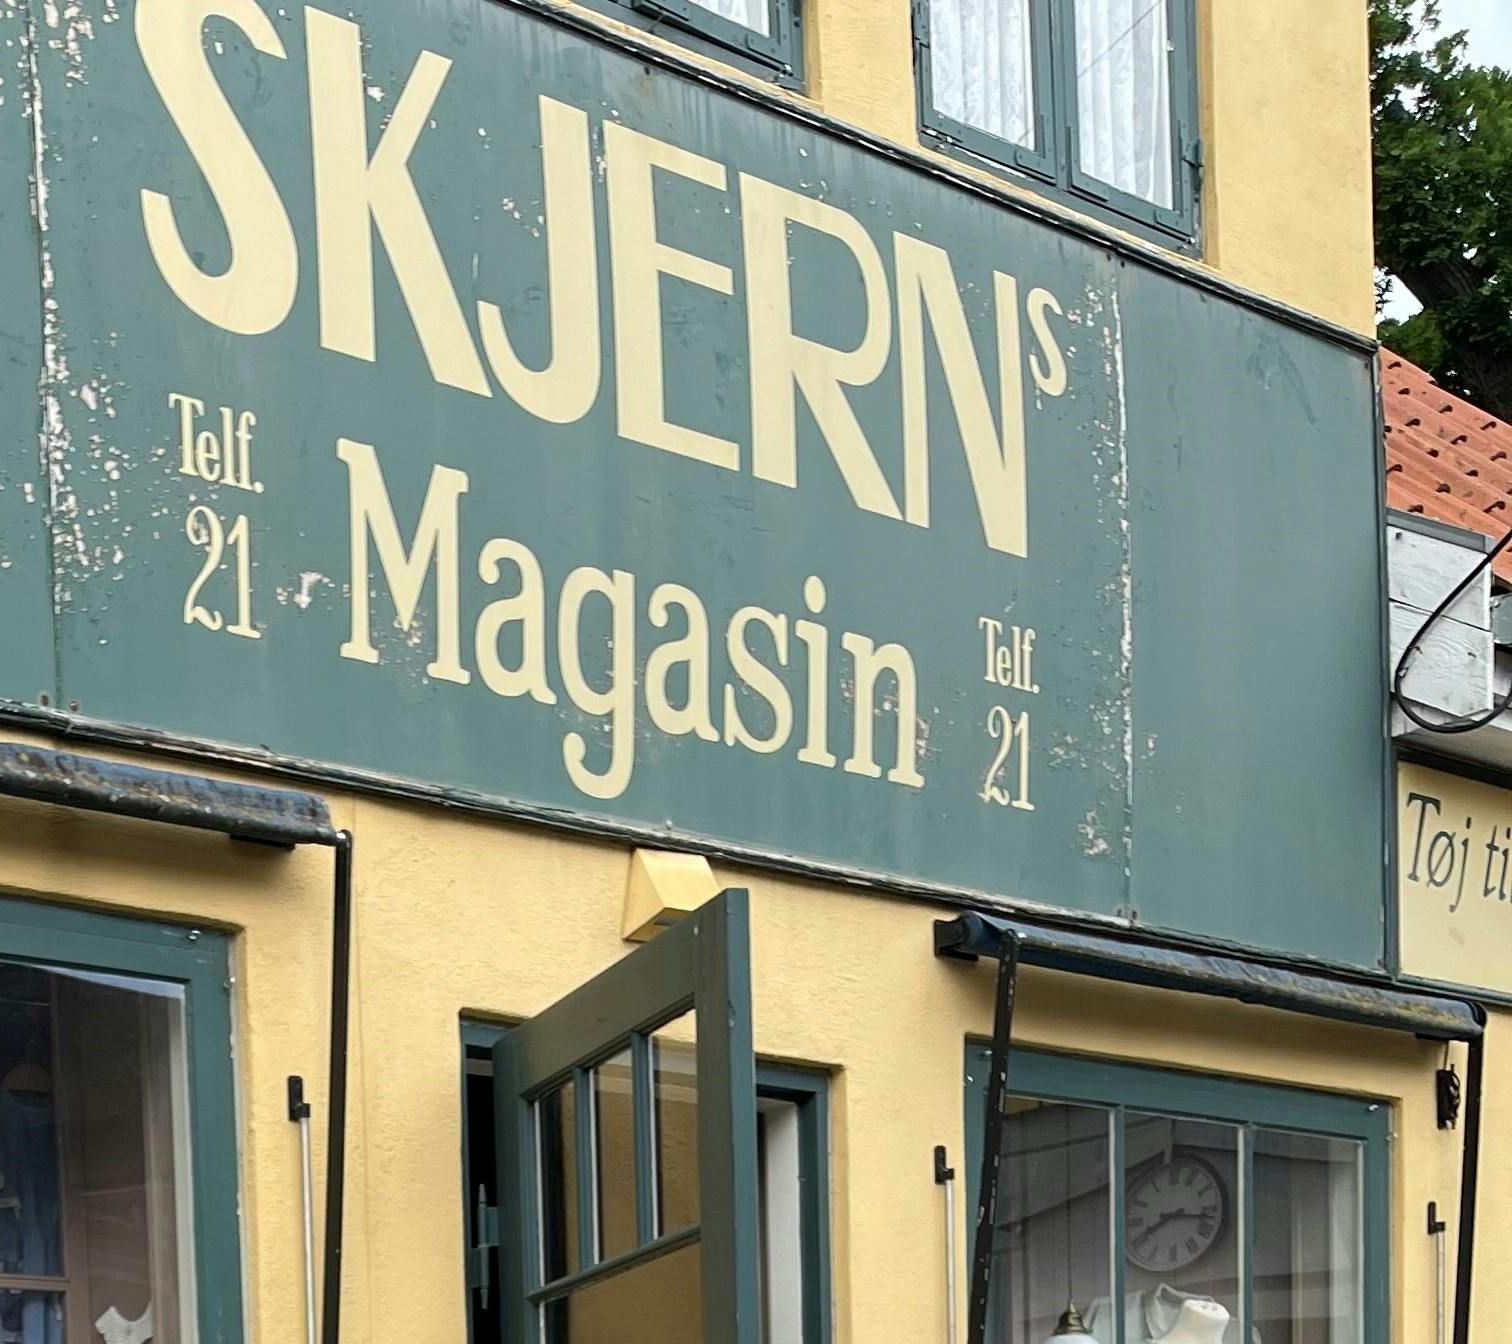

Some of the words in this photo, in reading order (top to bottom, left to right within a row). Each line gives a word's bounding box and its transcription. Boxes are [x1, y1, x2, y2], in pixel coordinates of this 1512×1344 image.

[168, 393, 264, 494] Telf.
[183, 504, 261, 638] 21
[335, 438, 925, 799] Magasin
[978, 616, 1042, 693] Telf.
[980, 704, 1036, 810] 21
[1407, 792, 1469, 912] Tøj
[1484, 825, 1512, 903] ti
